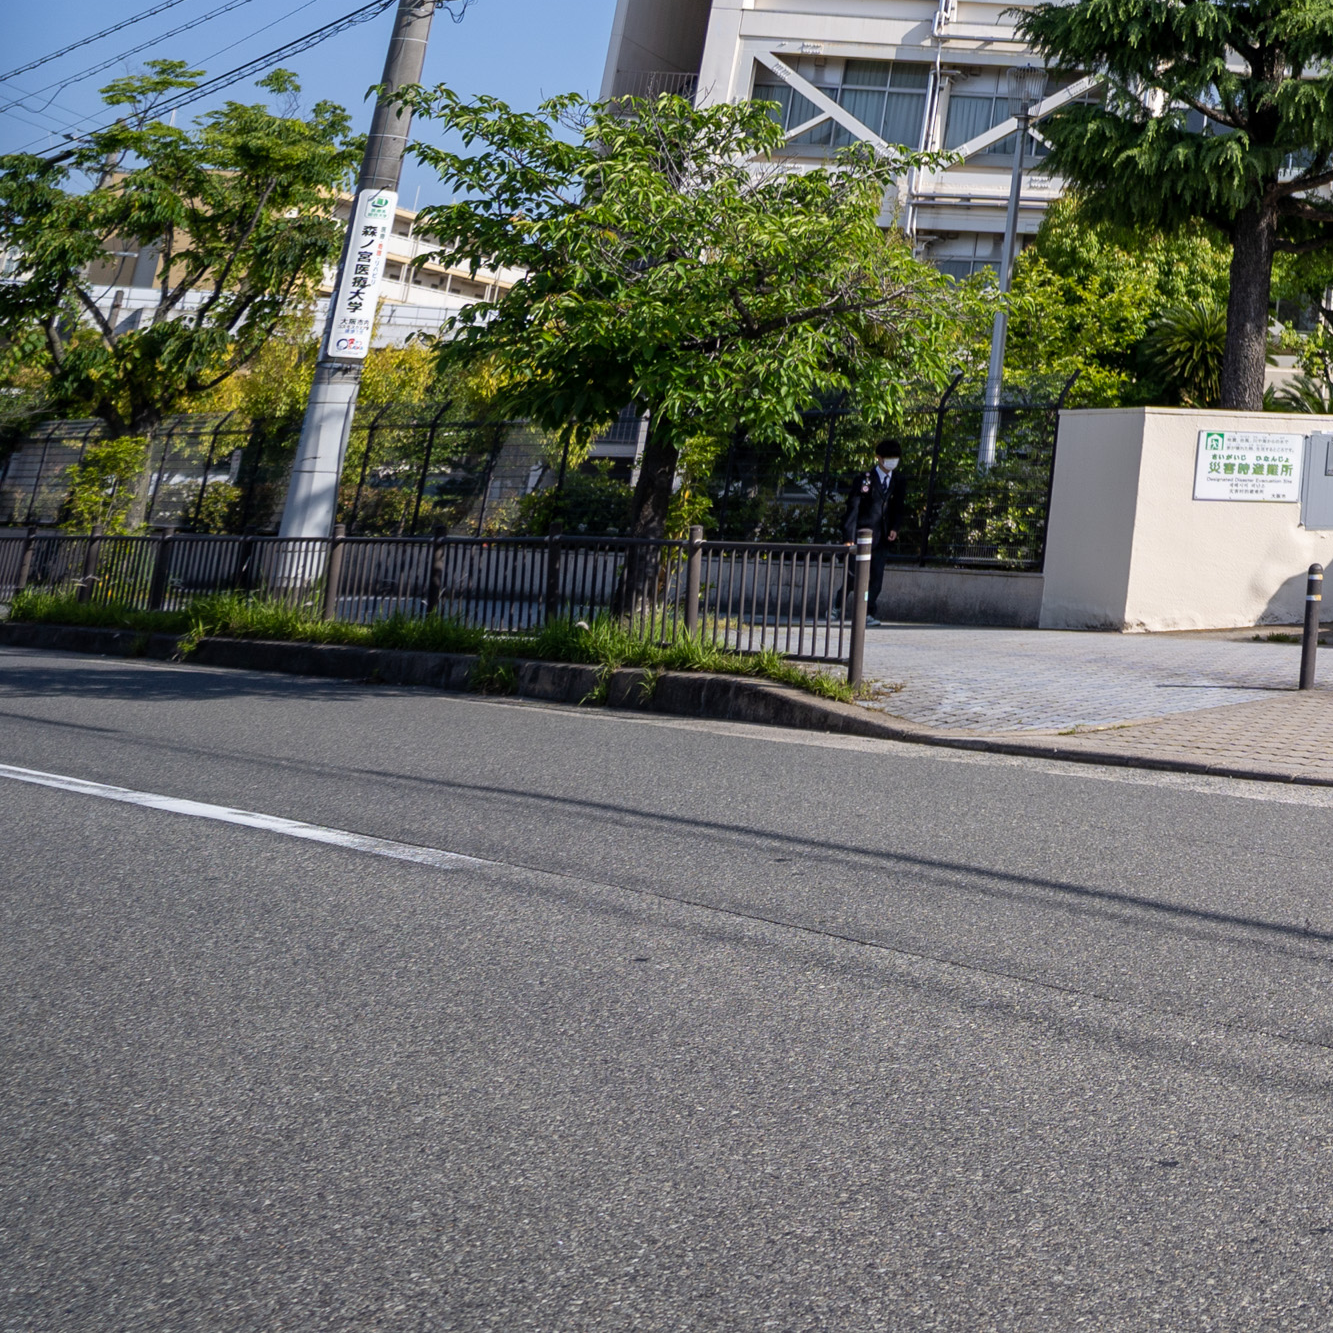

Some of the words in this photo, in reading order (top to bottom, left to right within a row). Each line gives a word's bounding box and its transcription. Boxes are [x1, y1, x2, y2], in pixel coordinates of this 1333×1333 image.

[346, 226, 378, 313] 森ノ宮医療大学
[1211, 453, 1247, 461] さいがいじ
[1255, 454, 1290, 463] ひなんじょ
[1208, 461, 1293, 476] 災害時避難所
